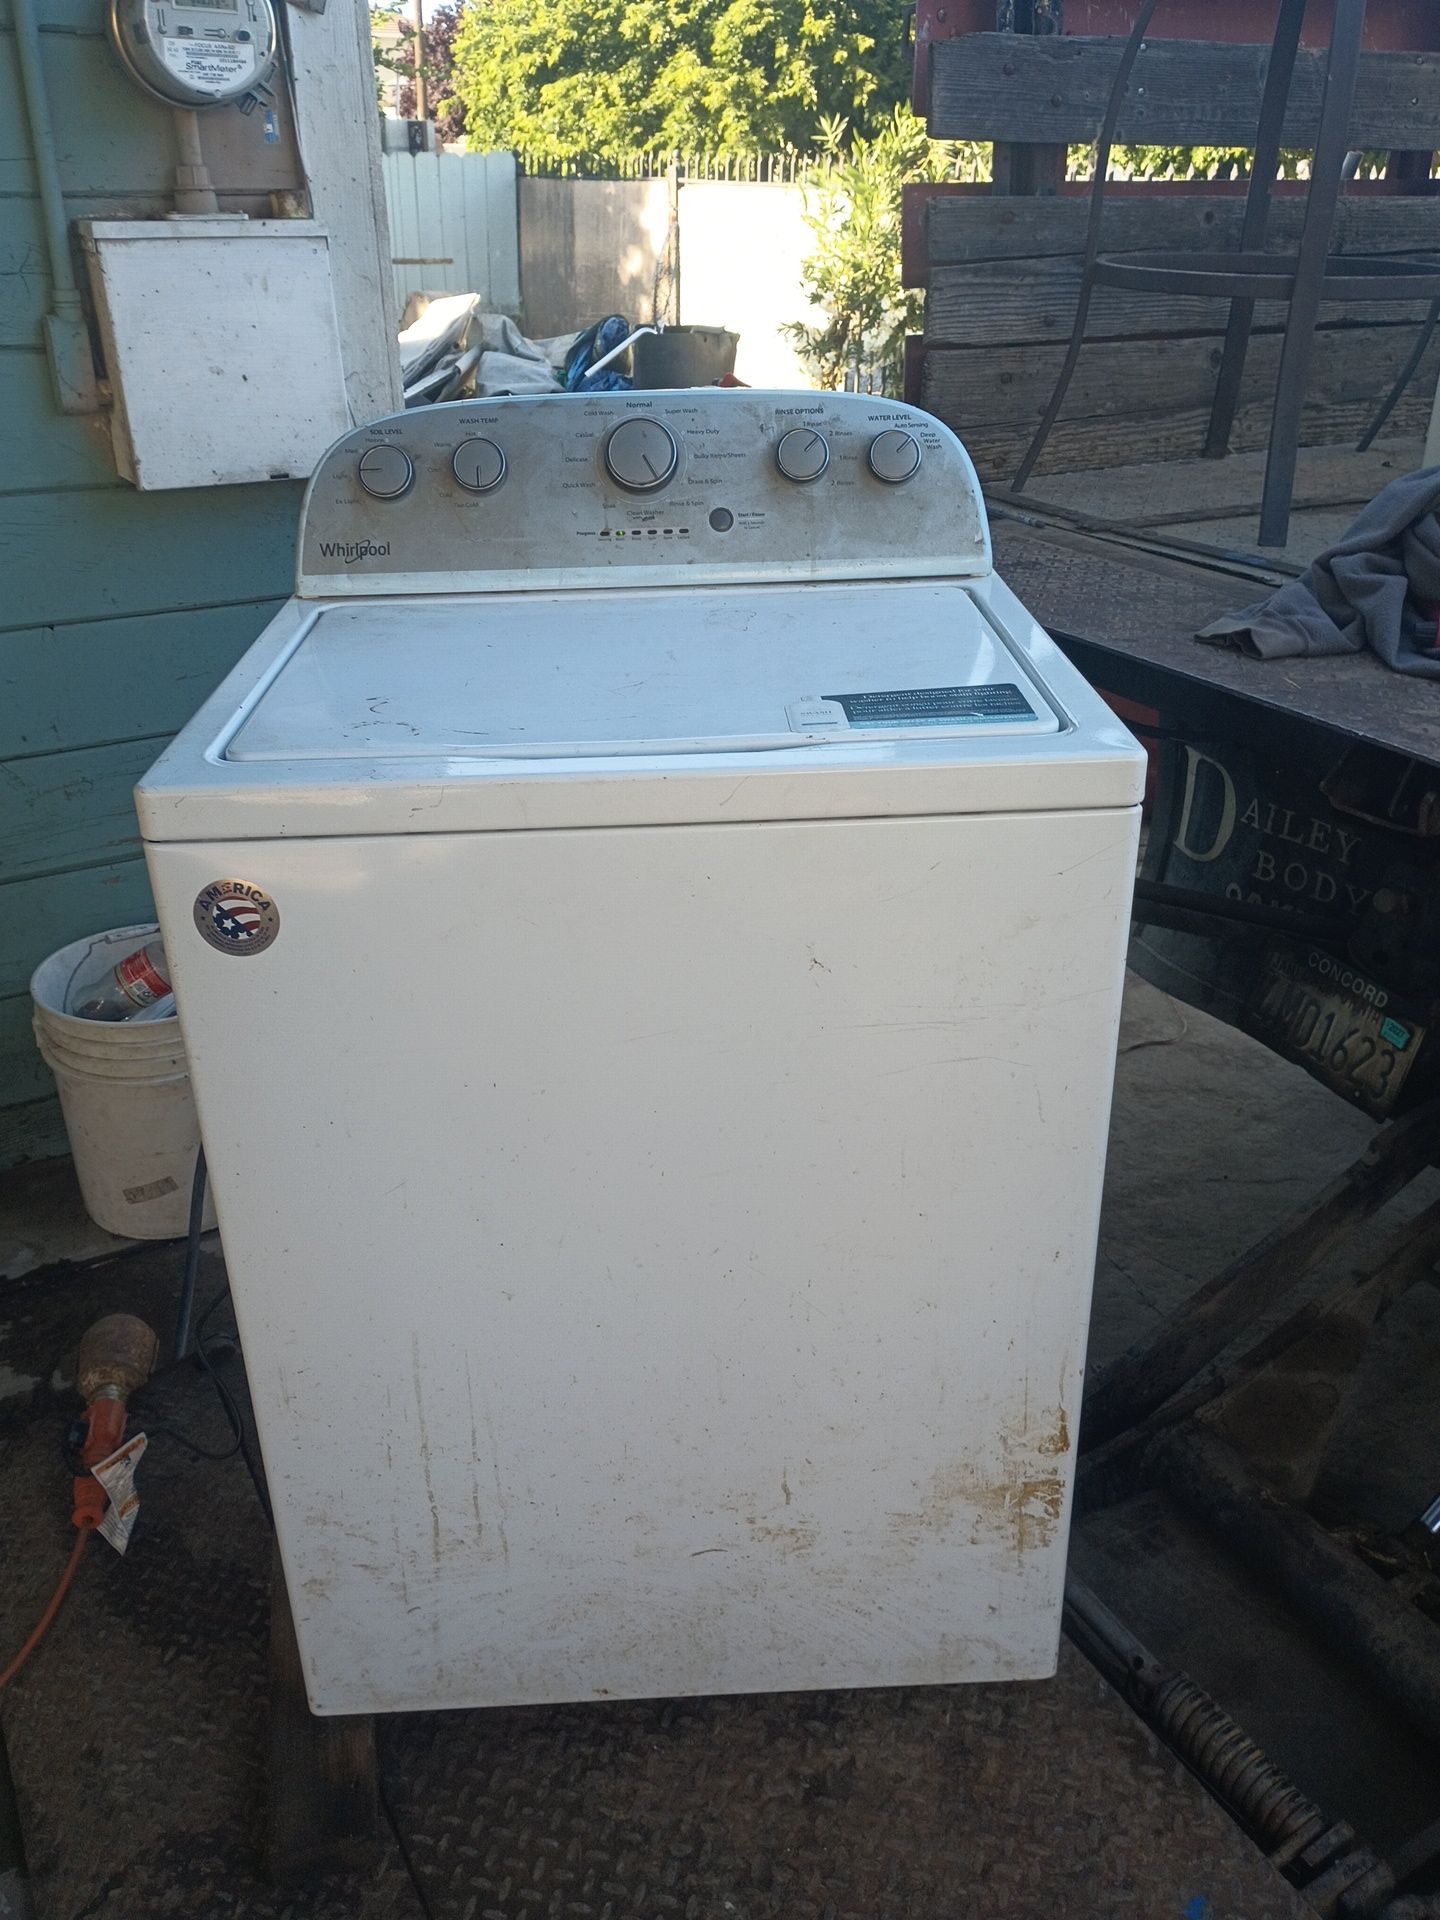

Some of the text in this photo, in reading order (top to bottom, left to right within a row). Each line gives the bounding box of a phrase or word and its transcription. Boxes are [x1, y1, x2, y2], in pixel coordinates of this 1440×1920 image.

[186, 62, 237, 73] SmartMeter
[626, 401, 652, 409] Normal
[795, 407, 824, 415] OPTIONS
[908, 422, 929, 430] Sensing
[706, 428, 720, 436] Duty
[920, 432, 936, 440] Deep
[709, 478, 723, 486] Spin
[319, 540, 391, 562] Whirlpool
[1172, 744, 1362, 866] DAILEY
[1255, 850, 1375, 918] BODY
[200, 882, 271, 911] AMERICA
[1307, 951, 1390, 1008] CONCORD
